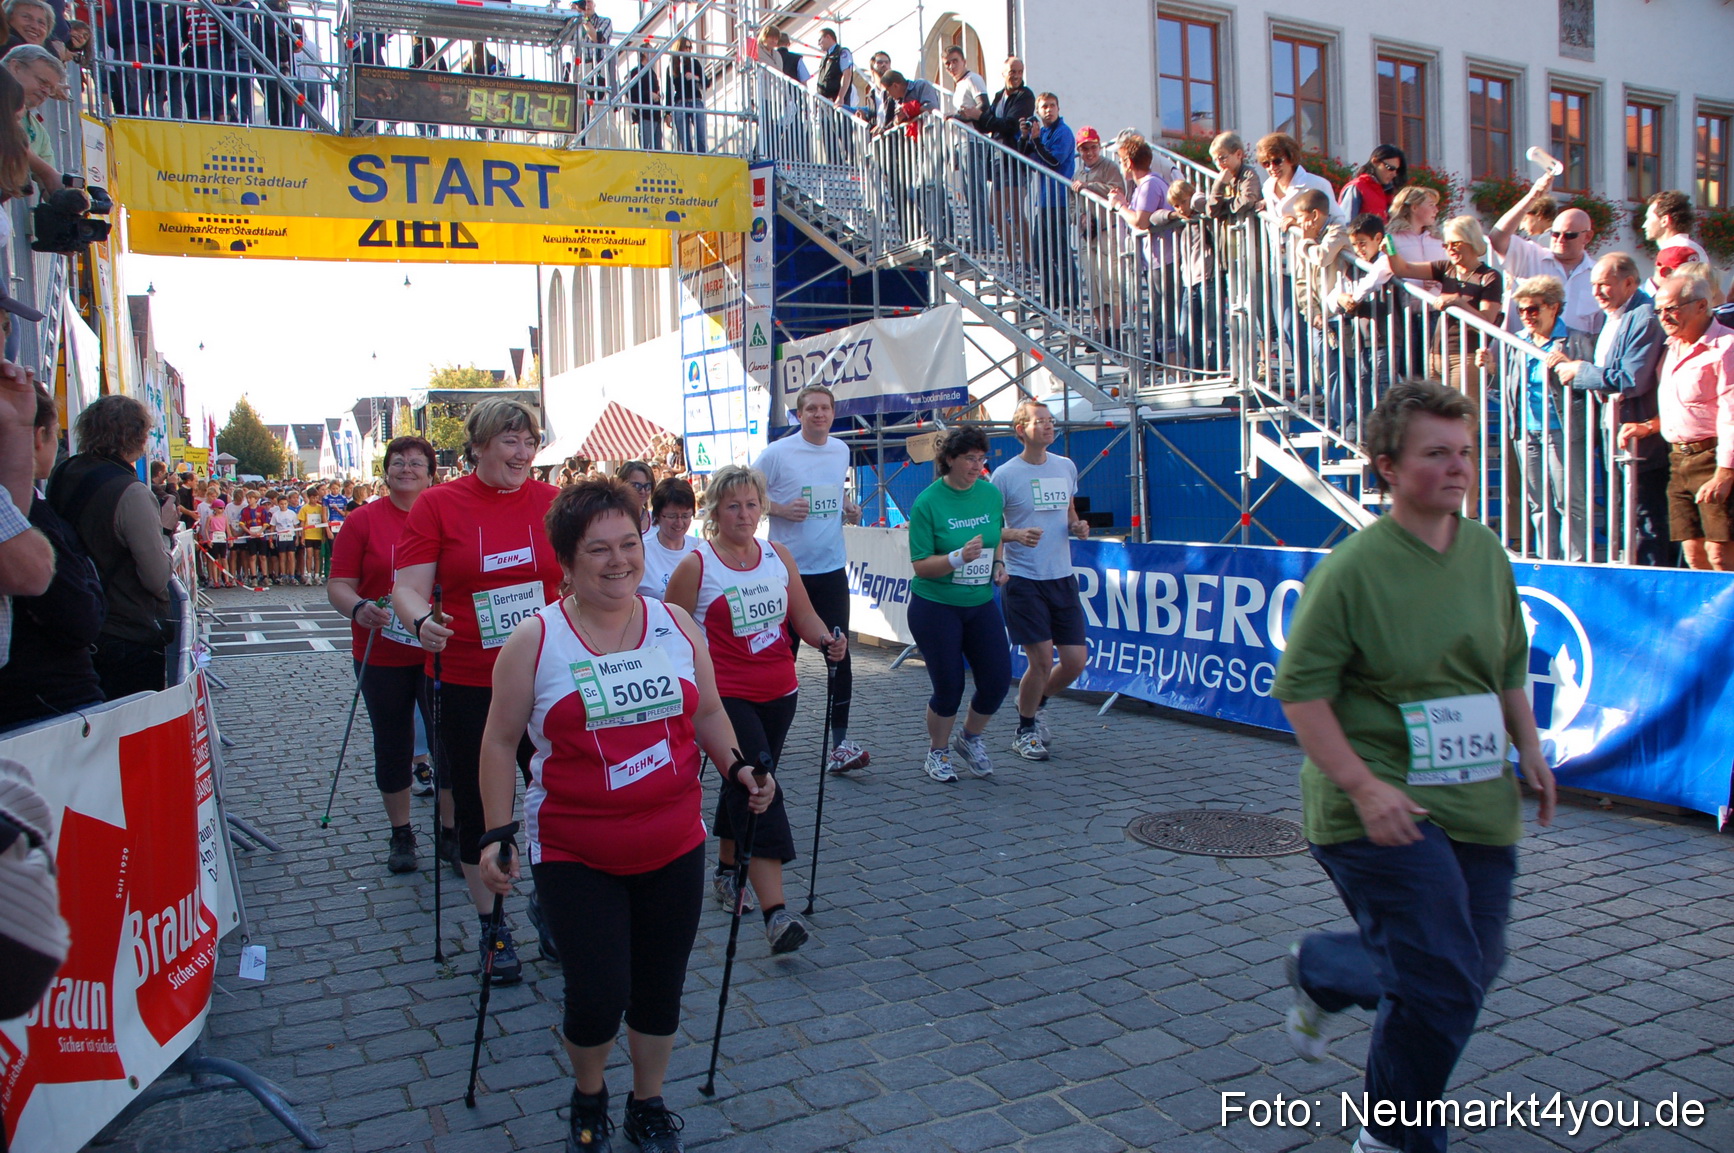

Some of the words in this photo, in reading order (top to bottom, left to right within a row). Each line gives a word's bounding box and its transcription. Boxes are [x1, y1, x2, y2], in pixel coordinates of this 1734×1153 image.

[427, 75, 477, 86] Elektronische
[156, 169, 241, 185] Neumarkter
[244, 175, 308, 189] Stadtlauf
[347, 153, 560, 210] START
[598, 192, 666, 205] Neumarkter
[668, 195, 719, 207] Stadtlauf
[158, 222, 231, 234] Neumarkter
[233, 226, 288, 237] Stadtlauf
[783, 338, 874, 394] BOCK
[197, 465, 205, 474] A
[1044, 491, 1067, 501] 5173
[815, 499, 837, 510] 5175
[947, 514, 990, 530] Sinupret
[497, 554, 519, 565] DEHN
[966, 564, 990, 576] 5068
[493, 587, 534, 606] Gertraud
[741, 584, 769, 598] Martha
[749, 598, 783, 619] 5061
[480, 614, 490, 623] Sc
[598, 659, 643, 677] Marion
[583, 687, 598, 698] Sc
[612, 675, 674, 706] 5062
[647, 703, 682, 718] PFLEIDERER
[1439, 731, 1498, 761] 5154
[627, 754, 655, 777] DEHN
[119, 847, 130, 874] 1929
[167, 962, 199, 990] Sicher
[192, 950, 211, 970] ist
[26, 976, 108, 1030] raun
[58, 1036, 84, 1053] Sicher
[85, 1038, 95, 1052] ist
[95, 1036, 118, 1053] sicher
